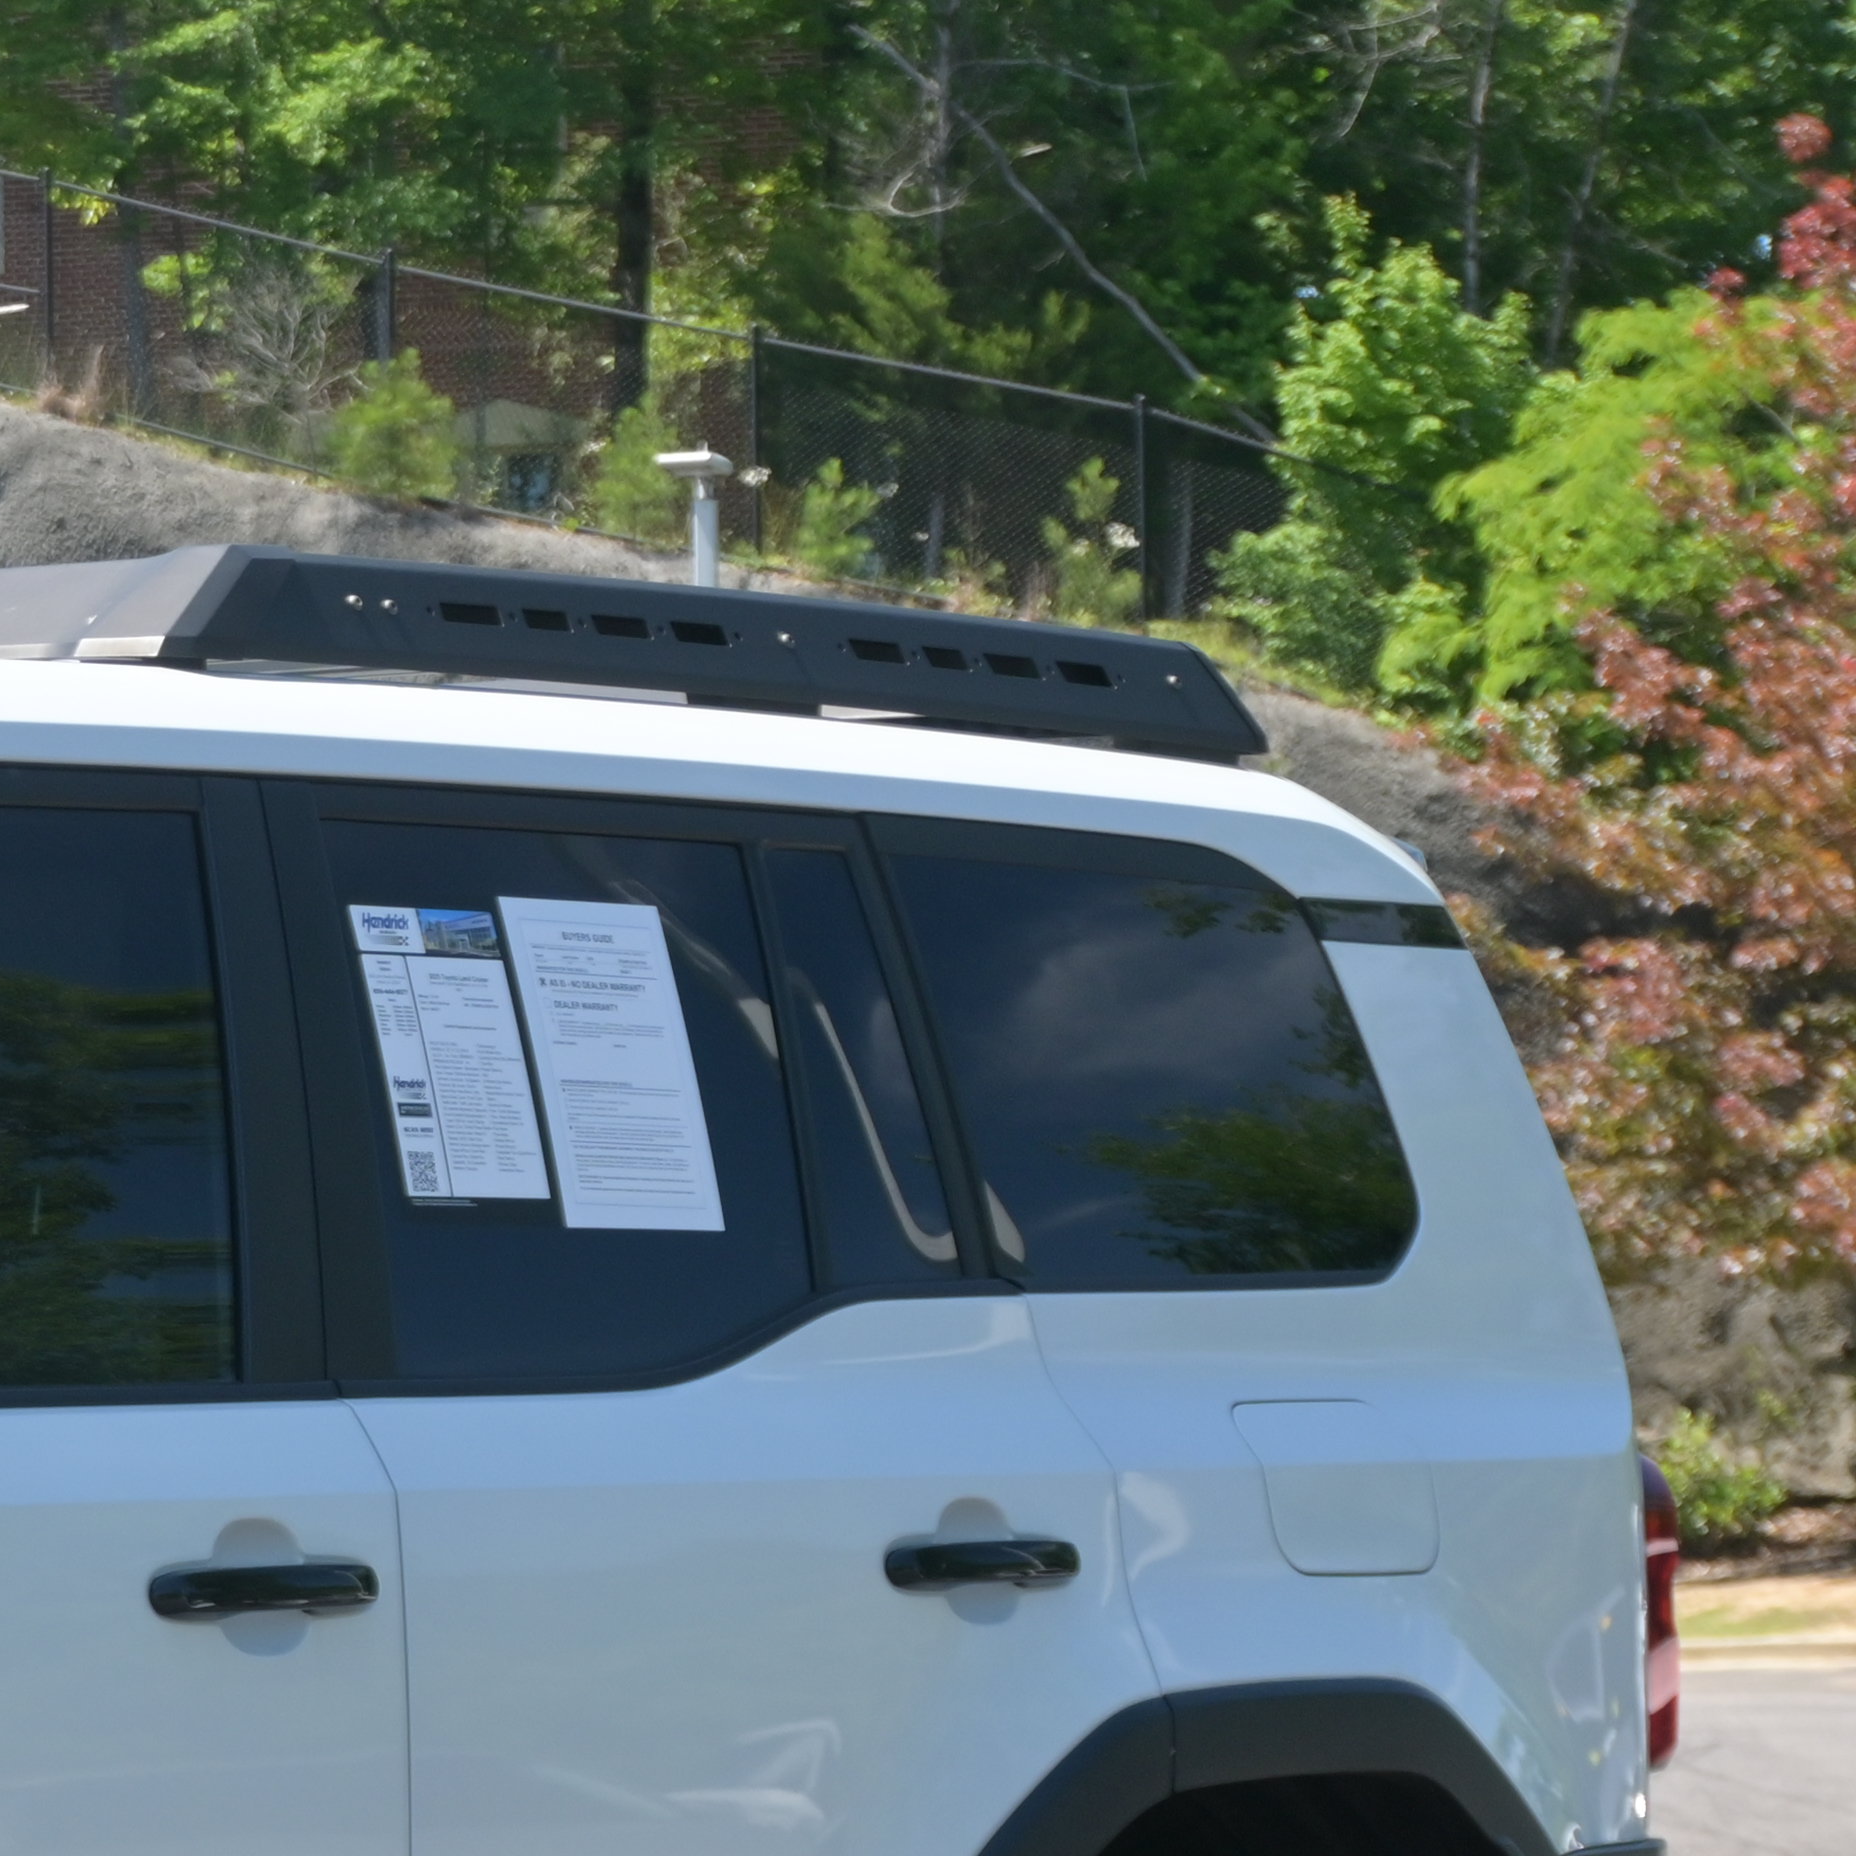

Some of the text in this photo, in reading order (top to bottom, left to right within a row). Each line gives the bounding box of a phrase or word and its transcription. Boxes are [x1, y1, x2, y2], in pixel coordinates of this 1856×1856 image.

[362, 912, 409, 933] Hendrick
[592, 933, 615, 944] GUIDE
[581, 980, 608, 991] DEALER
[609, 982, 646, 993] WARRANTY
[553, 1000, 619, 1012] DEALER WARRANTY
